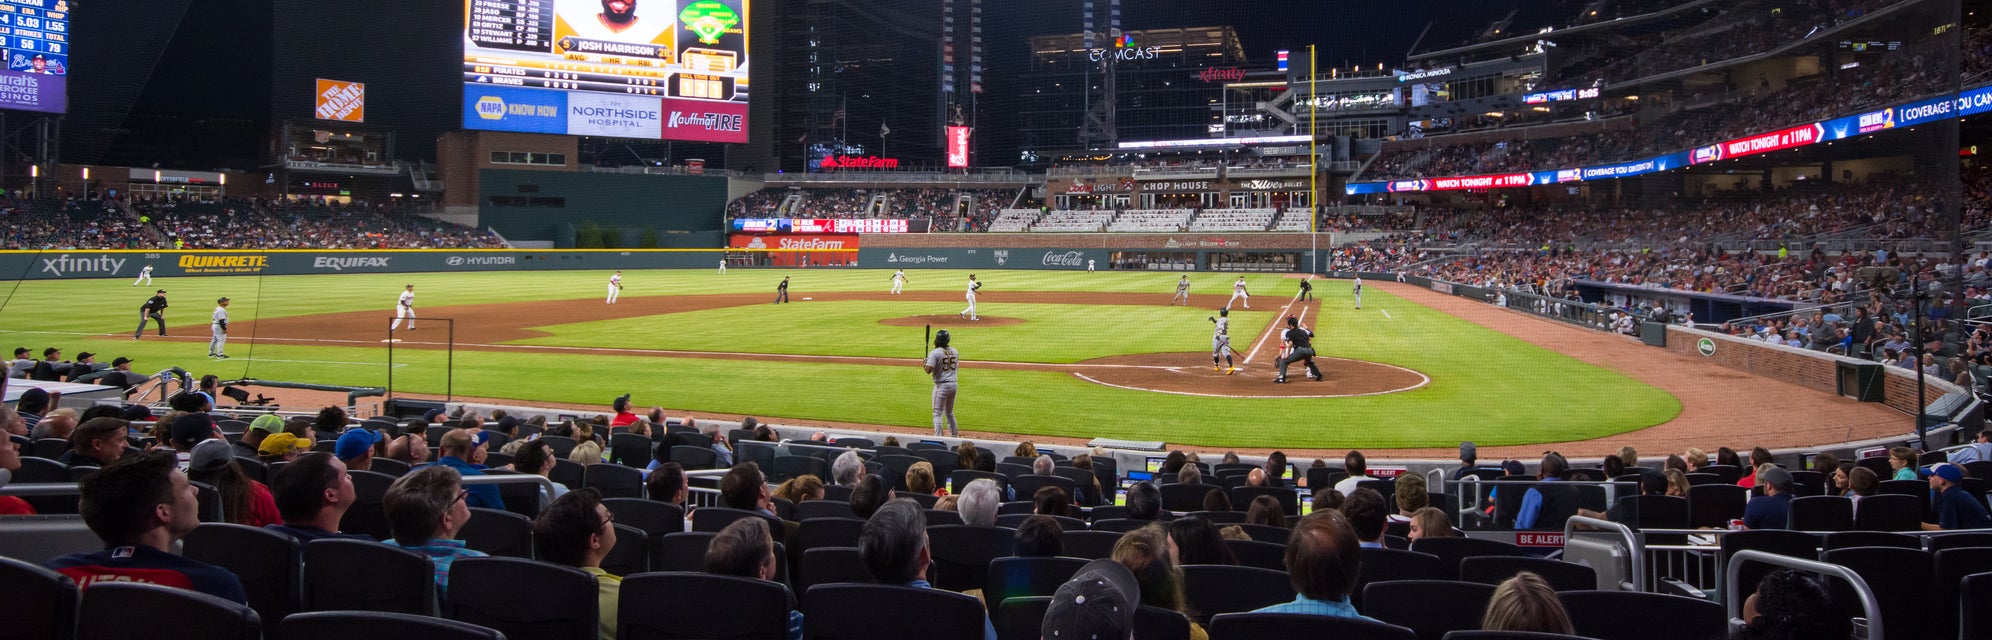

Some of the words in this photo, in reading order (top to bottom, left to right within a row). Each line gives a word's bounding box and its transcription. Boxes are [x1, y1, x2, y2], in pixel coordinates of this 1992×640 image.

[483, 1, 509, 9] FREESE
[47, 11, 65, 19] WHIP
[482, 15, 512, 23] MERCER
[17, 16, 39, 28] 5.03
[45, 20, 64, 32] 1.55
[15, 29, 42, 38] STRIKES
[45, 33, 65, 41] TOTAL
[481, 29, 513, 37] STEWART
[21, 39, 34, 49] 56
[480, 36, 513, 44] WILLIAMS
[48, 42, 61, 53] 79
[563, 39, 571, 48] 5
[578, 40, 602, 51] JOSH
[603, 43, 654, 56] HARRISON
[493, 67, 526, 75] PIRATES
[1200, 66, 1247, 83] xfinity
[1427, 68, 1451, 77] MINOLTA
[492, 77, 523, 85] BRAVES
[321, 84, 341, 100] THE
[1578, 88, 1599, 99] 9:05
[317, 83, 364, 119] HOME
[335, 98, 363, 120] DEPOT
[480, 102, 502, 113] NAPA
[509, 104, 535, 116] KNOW
[537, 105, 557, 117] HOW
[573, 106, 657, 120] NORTHSIDE
[1905, 101, 1950, 120] COVERAGE
[1952, 96, 1972, 110] YOU
[589, 119, 642, 127] HOSPITAL
[667, 111, 716, 128] Kauffman
[704, 113, 742, 131] TIRE
[1883, 107, 1895, 128] 2
[1729, 142, 1750, 154] WATCH
[1751, 135, 1779, 149] TONIGHT
[1790, 128, 1812, 143] 11PM
[1588, 168, 1615, 176] COVERAGE
[1615, 166, 1627, 174] YOU
[1143, 182, 1170, 190] CHOP
[1174, 181, 1208, 190] HOUSE
[1251, 180, 1282, 189] Silver
[1436, 180, 1460, 188] WATCH
[1461, 178, 1492, 187] TONIGHT
[1504, 175, 1526, 184] 11PM
[179, 255, 268, 268] QUIKRETE
[314, 256, 390, 270] EQUIFAX
[467, 256, 515, 265] HYUNDAI
[900, 255, 926, 264] Georgia
[1042, 251, 1085, 266] Coca-Cola
[42, 254, 126, 276] xfinity
[942, 356, 956, 371] 55
[1520, 535, 1533, 544] BE
[1536, 535, 1566, 544] ALERT
